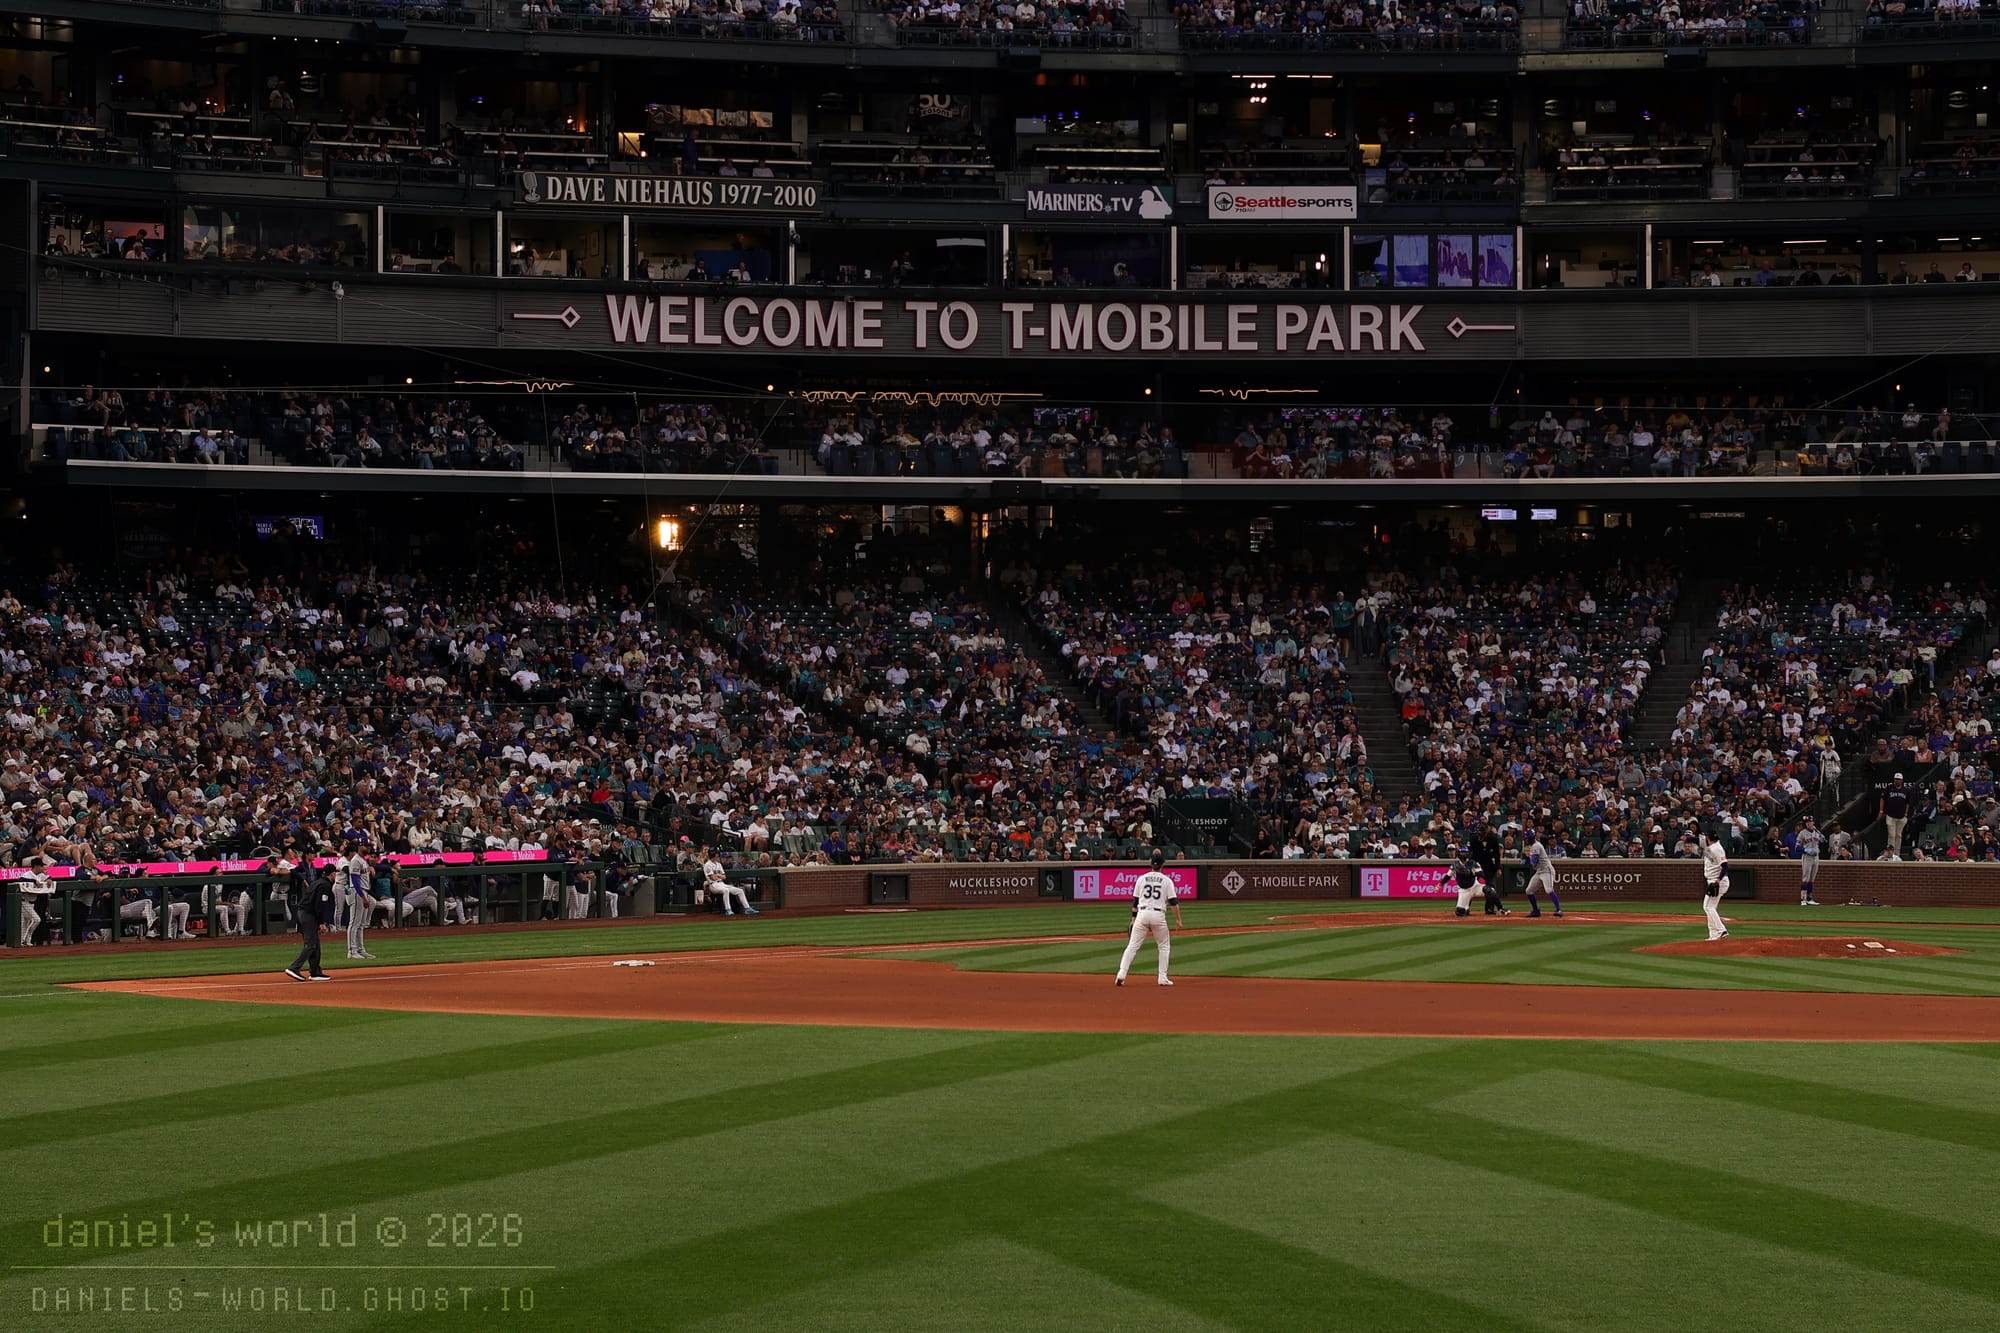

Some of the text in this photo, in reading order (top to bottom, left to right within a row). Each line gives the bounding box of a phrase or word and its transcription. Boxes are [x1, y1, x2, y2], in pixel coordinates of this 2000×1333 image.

[546, 176, 816, 207] DAVE NIEHAUS 1977-2010
[605, 294, 1426, 351] WELCOME TO T-MOBILE PARK
[1252, 875, 1340, 887] T-MOBILE PARK
[1407, 871, 1430, 881] It's
[1554, 873, 1642, 883] UCKLESHOOT
[949, 877, 1035, 888] MUCKLESHOOT
[1104, 885, 1134, 895] Best
[1143, 885, 1162, 900] 35
